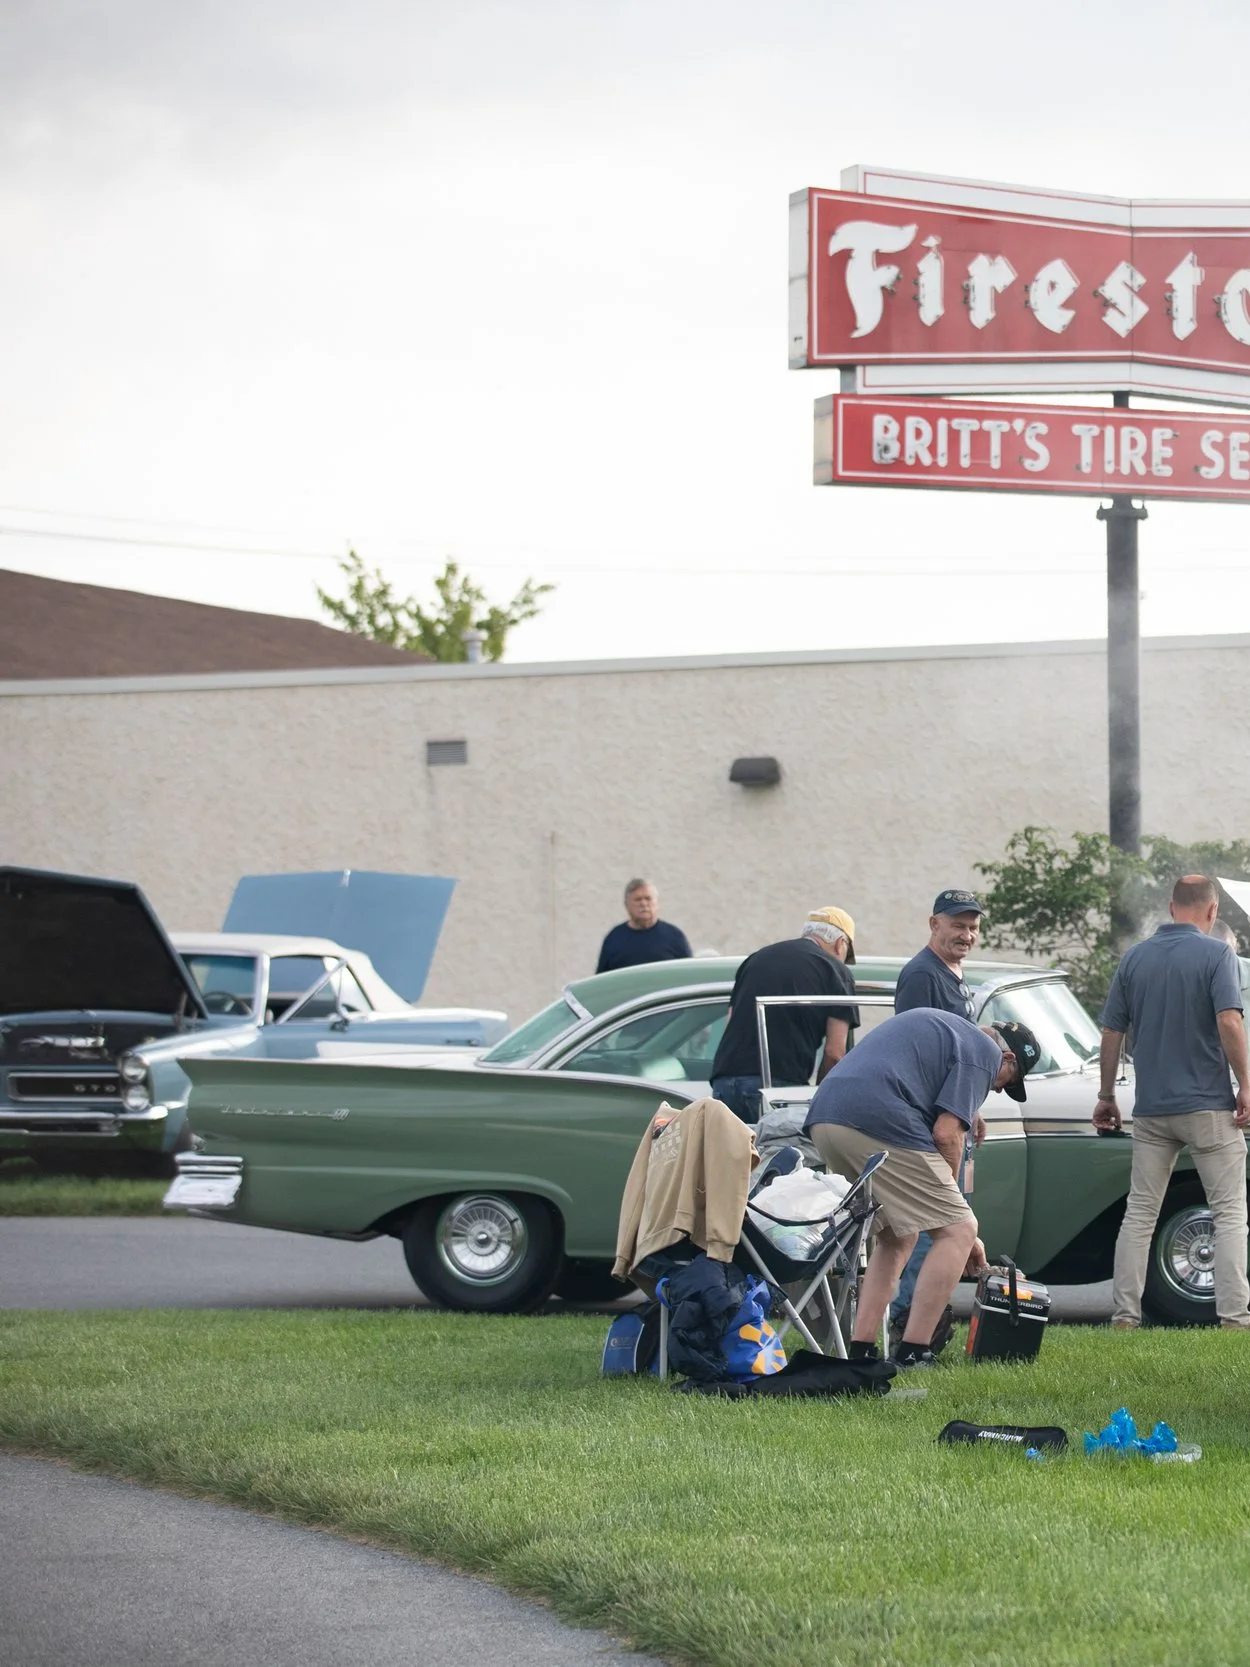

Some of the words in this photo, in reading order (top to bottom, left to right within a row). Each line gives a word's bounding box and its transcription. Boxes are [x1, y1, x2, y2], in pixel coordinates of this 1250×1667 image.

[873, 414, 1050, 472] BRITT'S
[1071, 424, 1177, 477] TIRE
[990, 1295, 1043, 1310] THUNERBIRD
